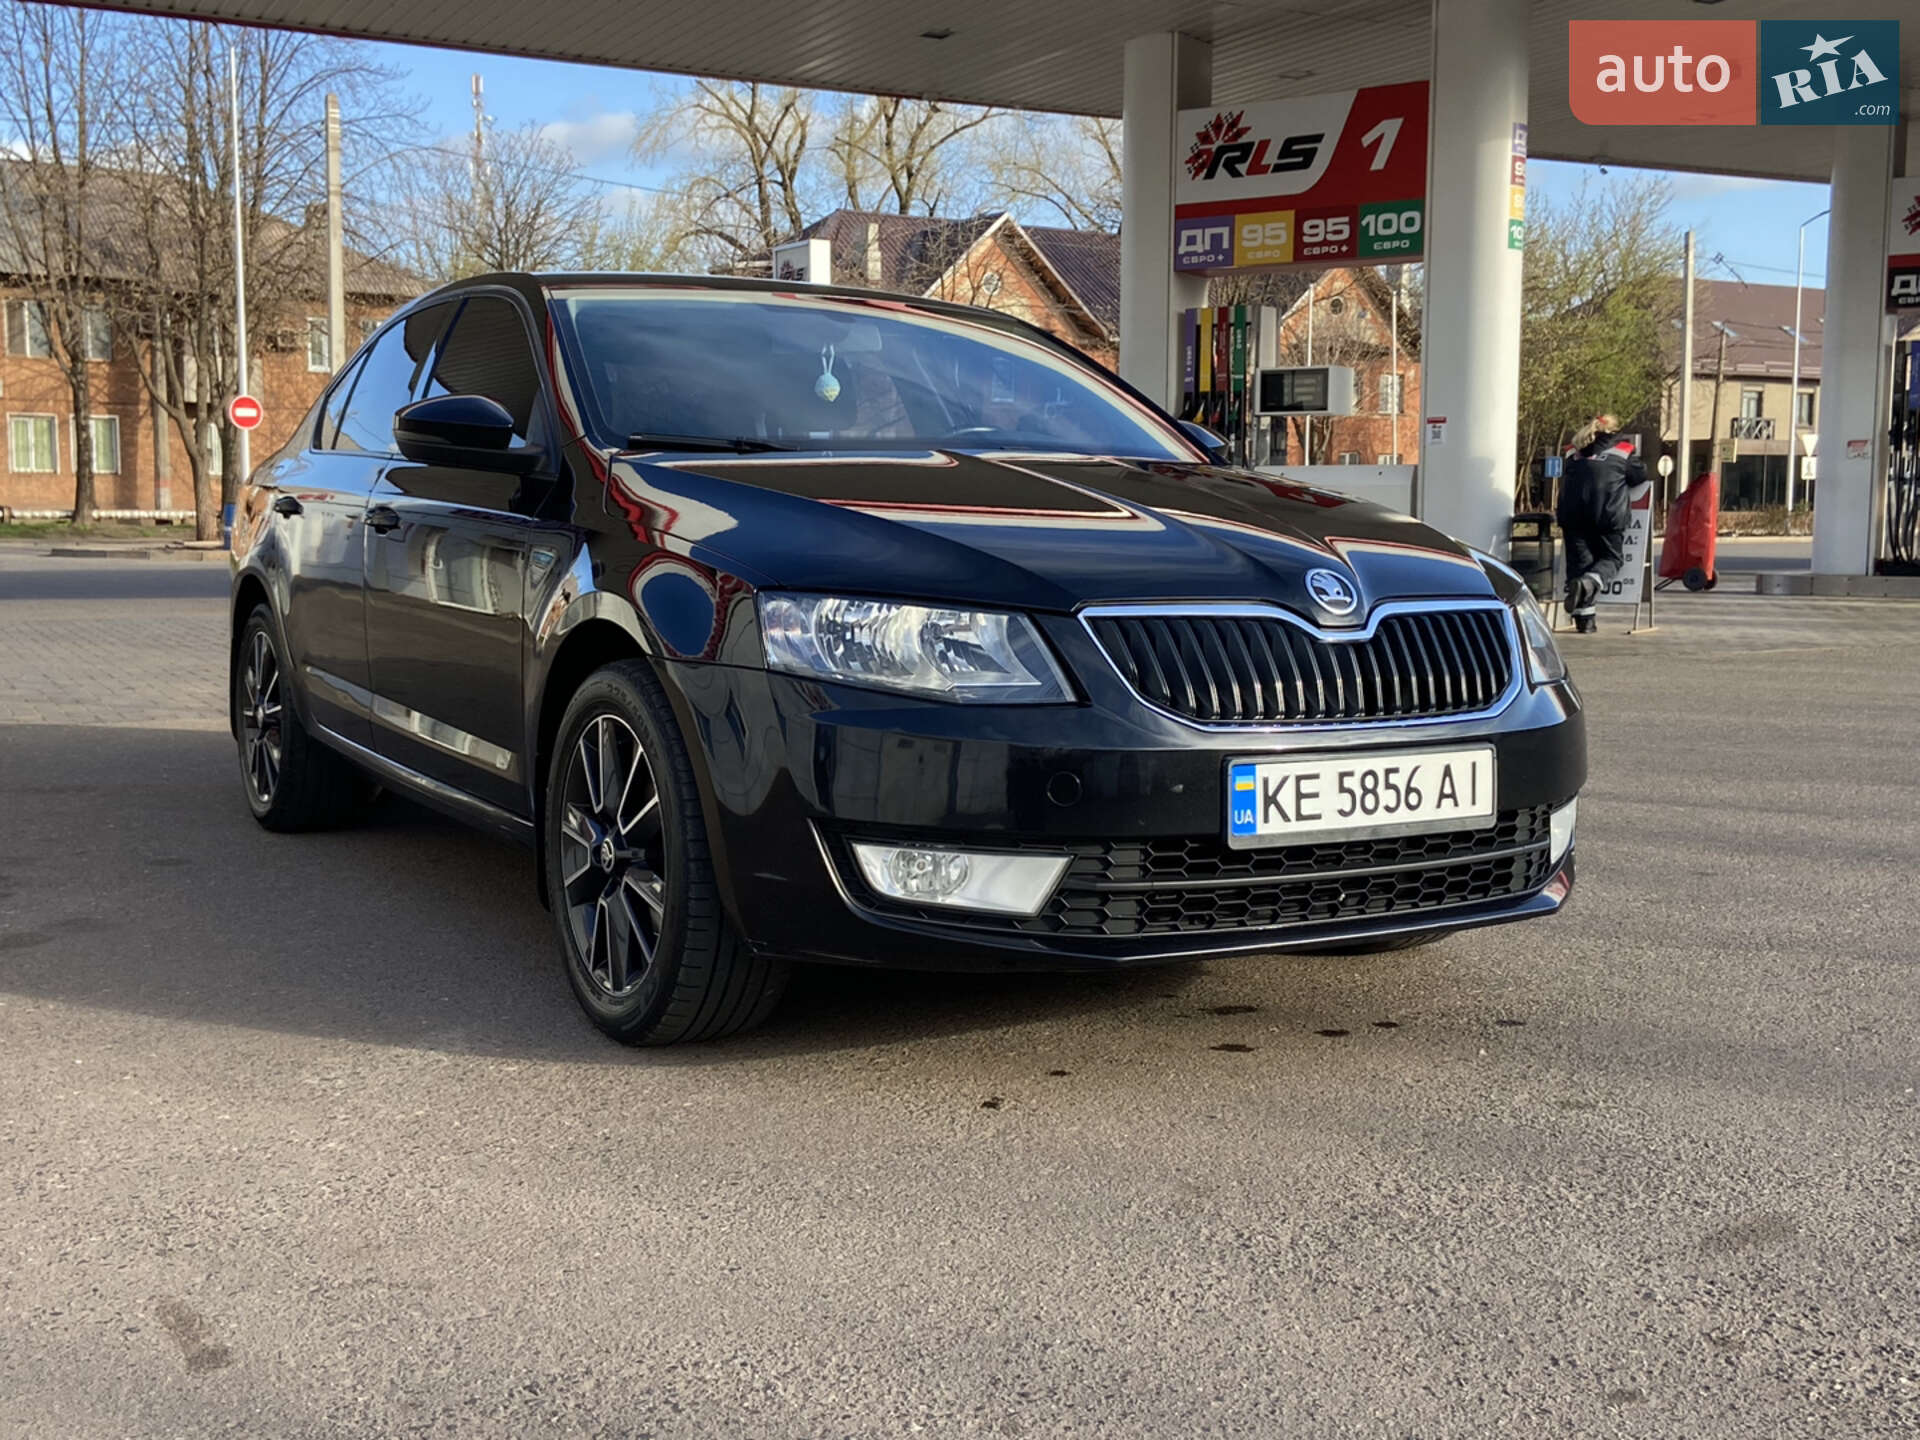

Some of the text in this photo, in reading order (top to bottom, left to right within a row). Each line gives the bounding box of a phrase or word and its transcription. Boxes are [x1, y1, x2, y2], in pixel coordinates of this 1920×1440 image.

[1202, 133, 1326, 180] RLS
[1361, 117, 1404, 171] 1
[1241, 221, 1287, 248] 95
[1303, 217, 1350, 243] 95
[1361, 211, 1421, 237] 100
[1178, 226, 1230, 255] ДП
[1891, 274, 1920, 297] Д
[1262, 773, 1322, 824] KE
[1337, 765, 1423, 818] 5856
[1234, 809, 1254, 824] UA
